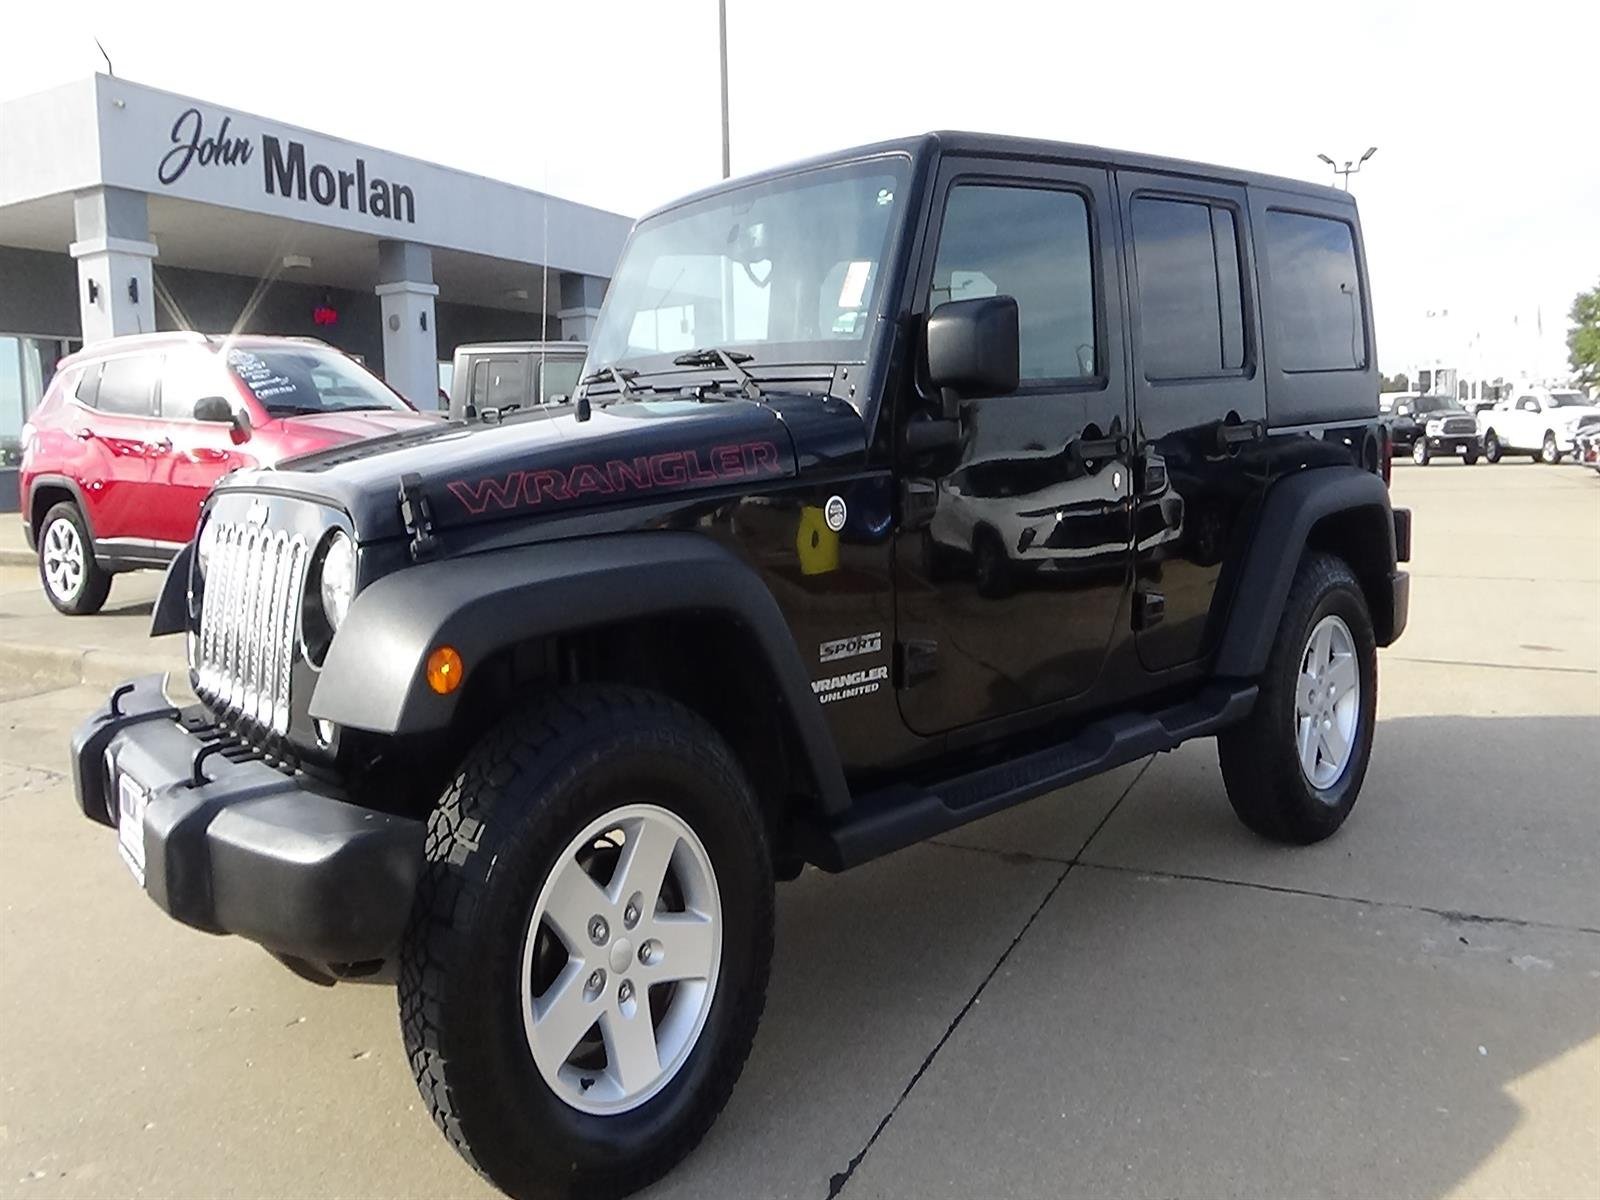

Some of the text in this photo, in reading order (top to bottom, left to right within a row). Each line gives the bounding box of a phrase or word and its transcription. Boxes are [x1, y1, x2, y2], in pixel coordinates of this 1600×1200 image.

[158, 108, 415, 224] John Morlan
[447, 440, 782, 514] WRANGLER
[824, 638, 876, 655] SPORT
[819, 682, 879, 703] UNLIMITED
